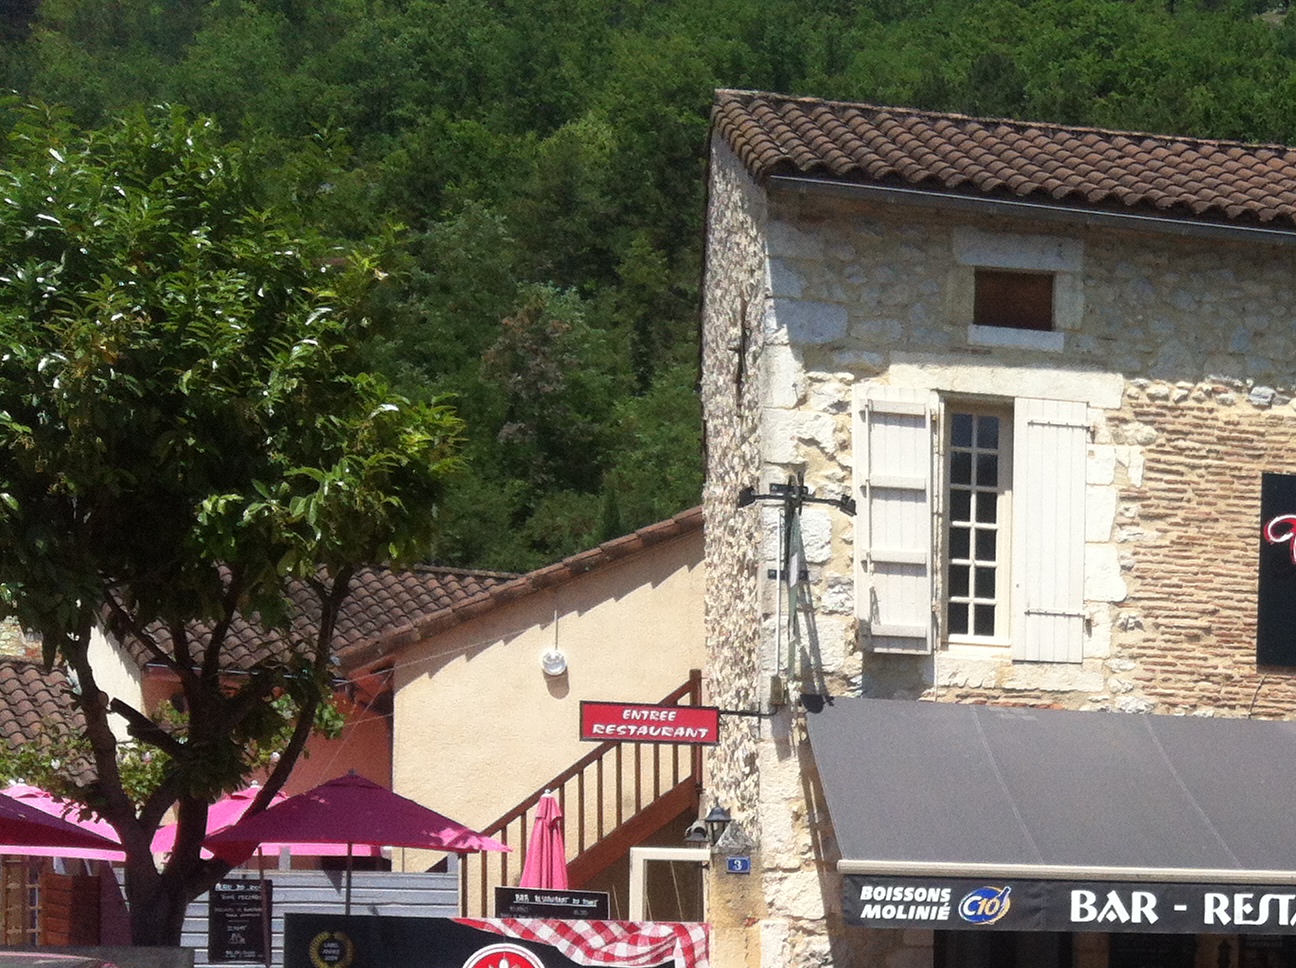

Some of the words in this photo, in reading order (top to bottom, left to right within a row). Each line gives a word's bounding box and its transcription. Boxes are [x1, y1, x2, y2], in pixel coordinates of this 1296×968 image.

[622, 708, 677, 721] ENTREE
[591, 723, 709, 739] RESTAURANT
[732, 859, 743, 871] 3
[860, 885, 952, 904] BOISSONS
[860, 902, 952, 921] MOLINIÉ
[963, 895, 1000, 917] C10
[1069, 889, 1159, 925] BAR
